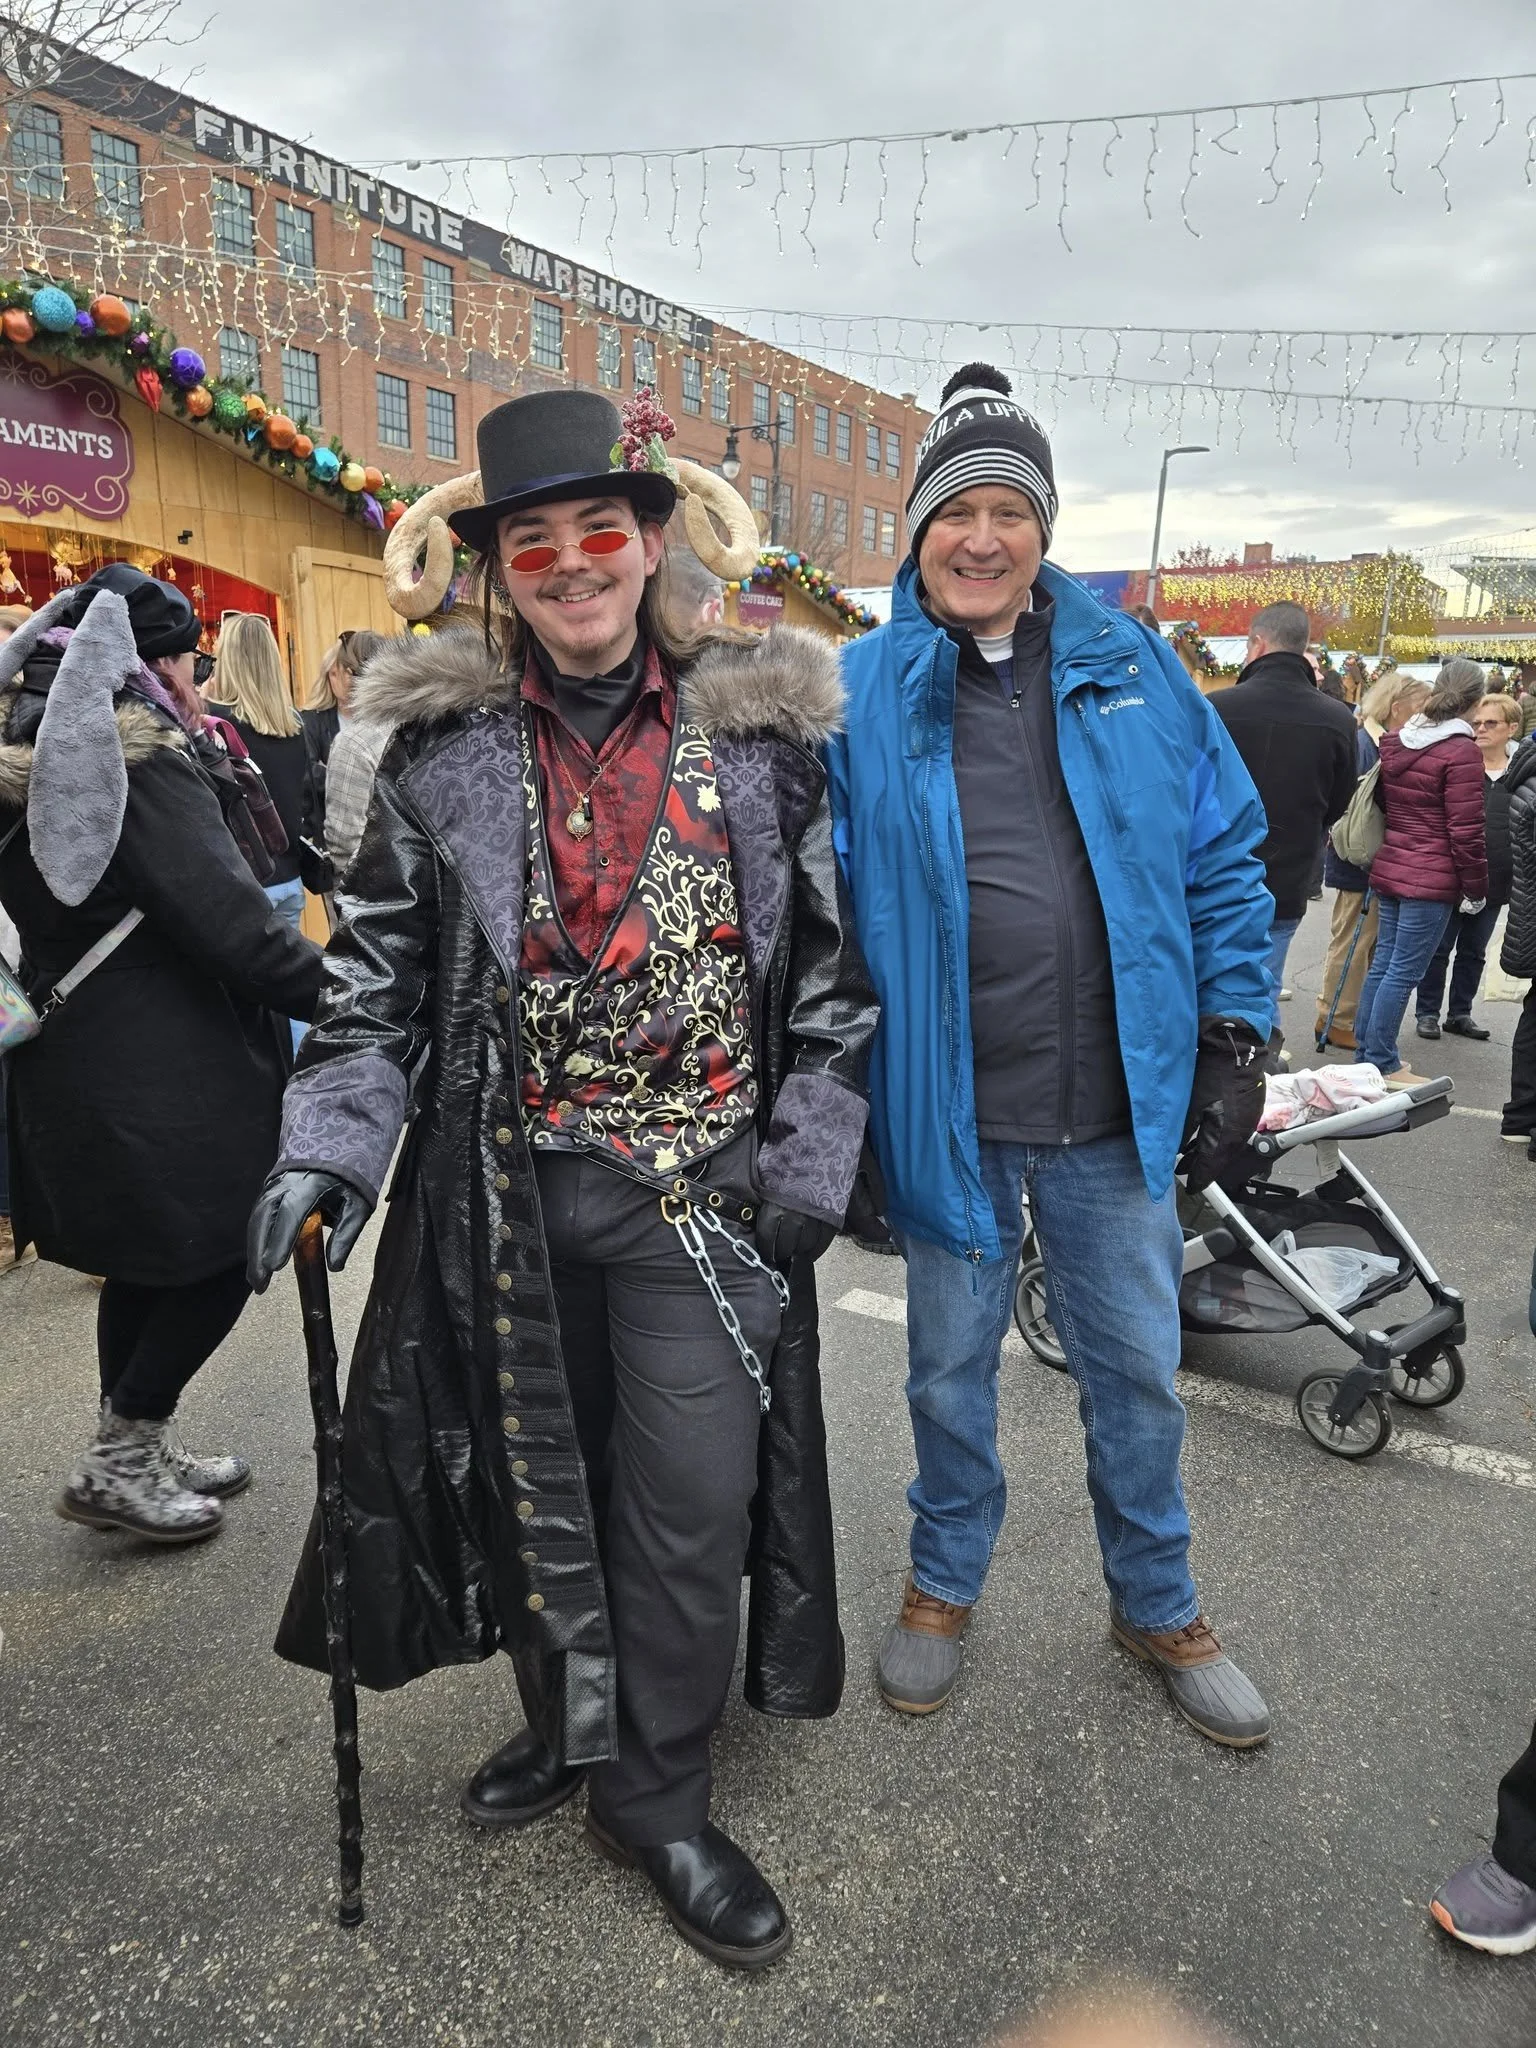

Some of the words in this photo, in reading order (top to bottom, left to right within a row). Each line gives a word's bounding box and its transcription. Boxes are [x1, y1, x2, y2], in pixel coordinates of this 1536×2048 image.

[194, 106, 464, 251] FURNITURE
[508, 241, 693, 341] WAREHOUSE
[740, 593, 766, 605] COFFEE
[1108, 696, 1145, 710] Columbia
